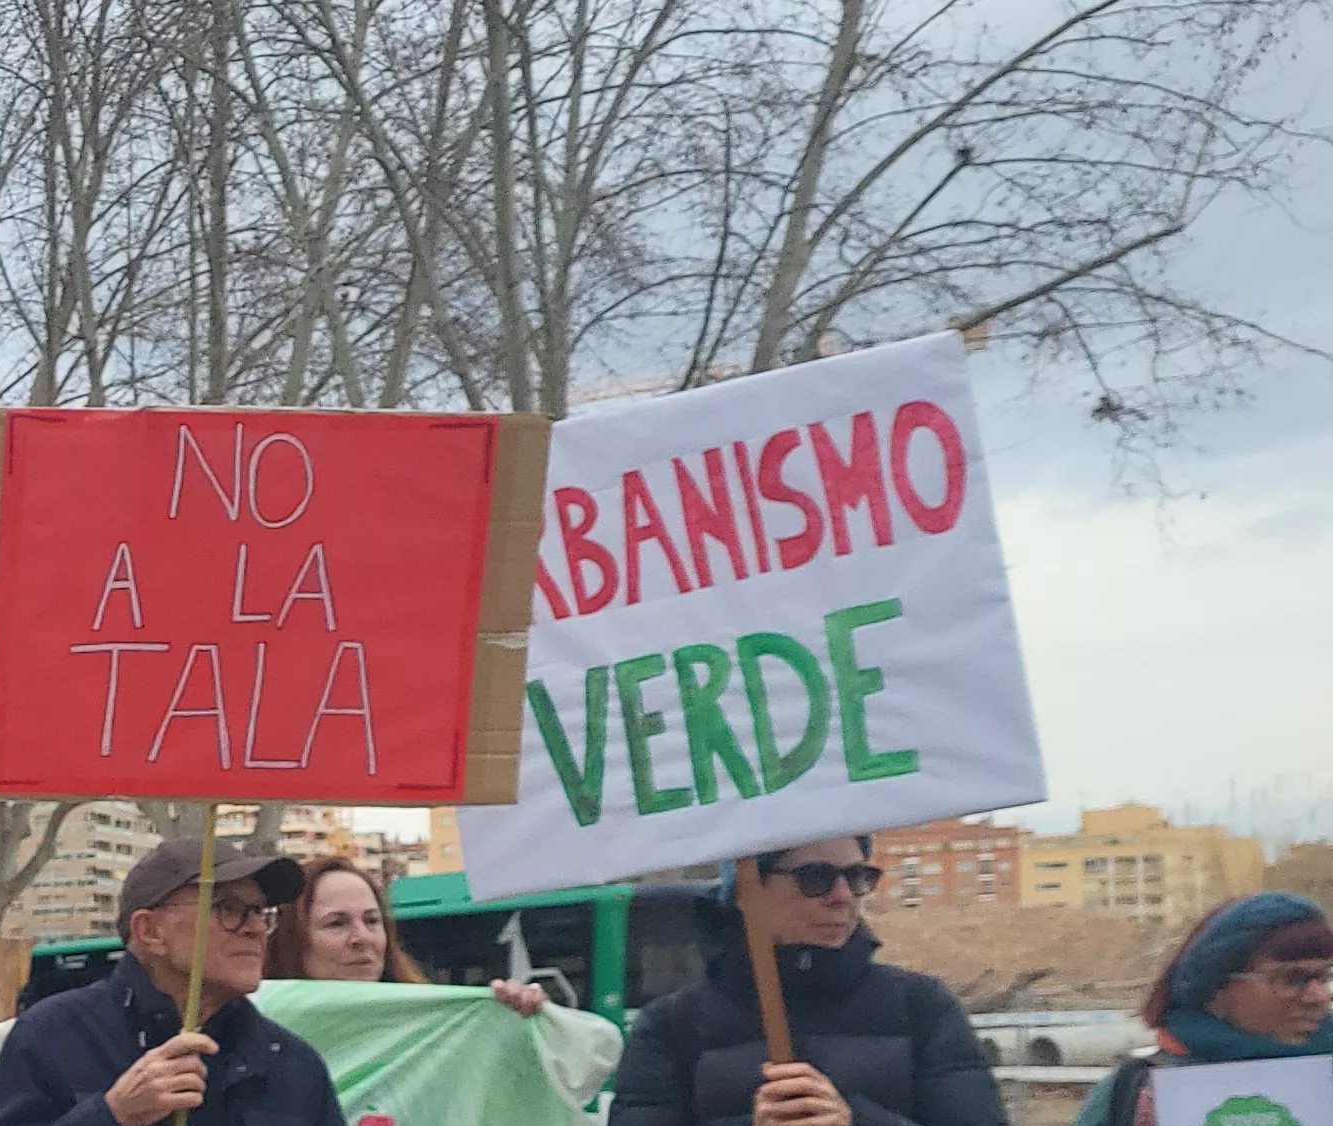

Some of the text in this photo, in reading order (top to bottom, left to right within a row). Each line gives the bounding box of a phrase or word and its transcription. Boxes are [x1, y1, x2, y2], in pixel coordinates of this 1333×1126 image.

[169, 422, 315, 529] NO
[533, 400, 968, 620] BANISMO
[92, 542, 337, 632] A LA
[70, 640, 378, 776] TALA
[526, 598, 922, 828] VERDE
